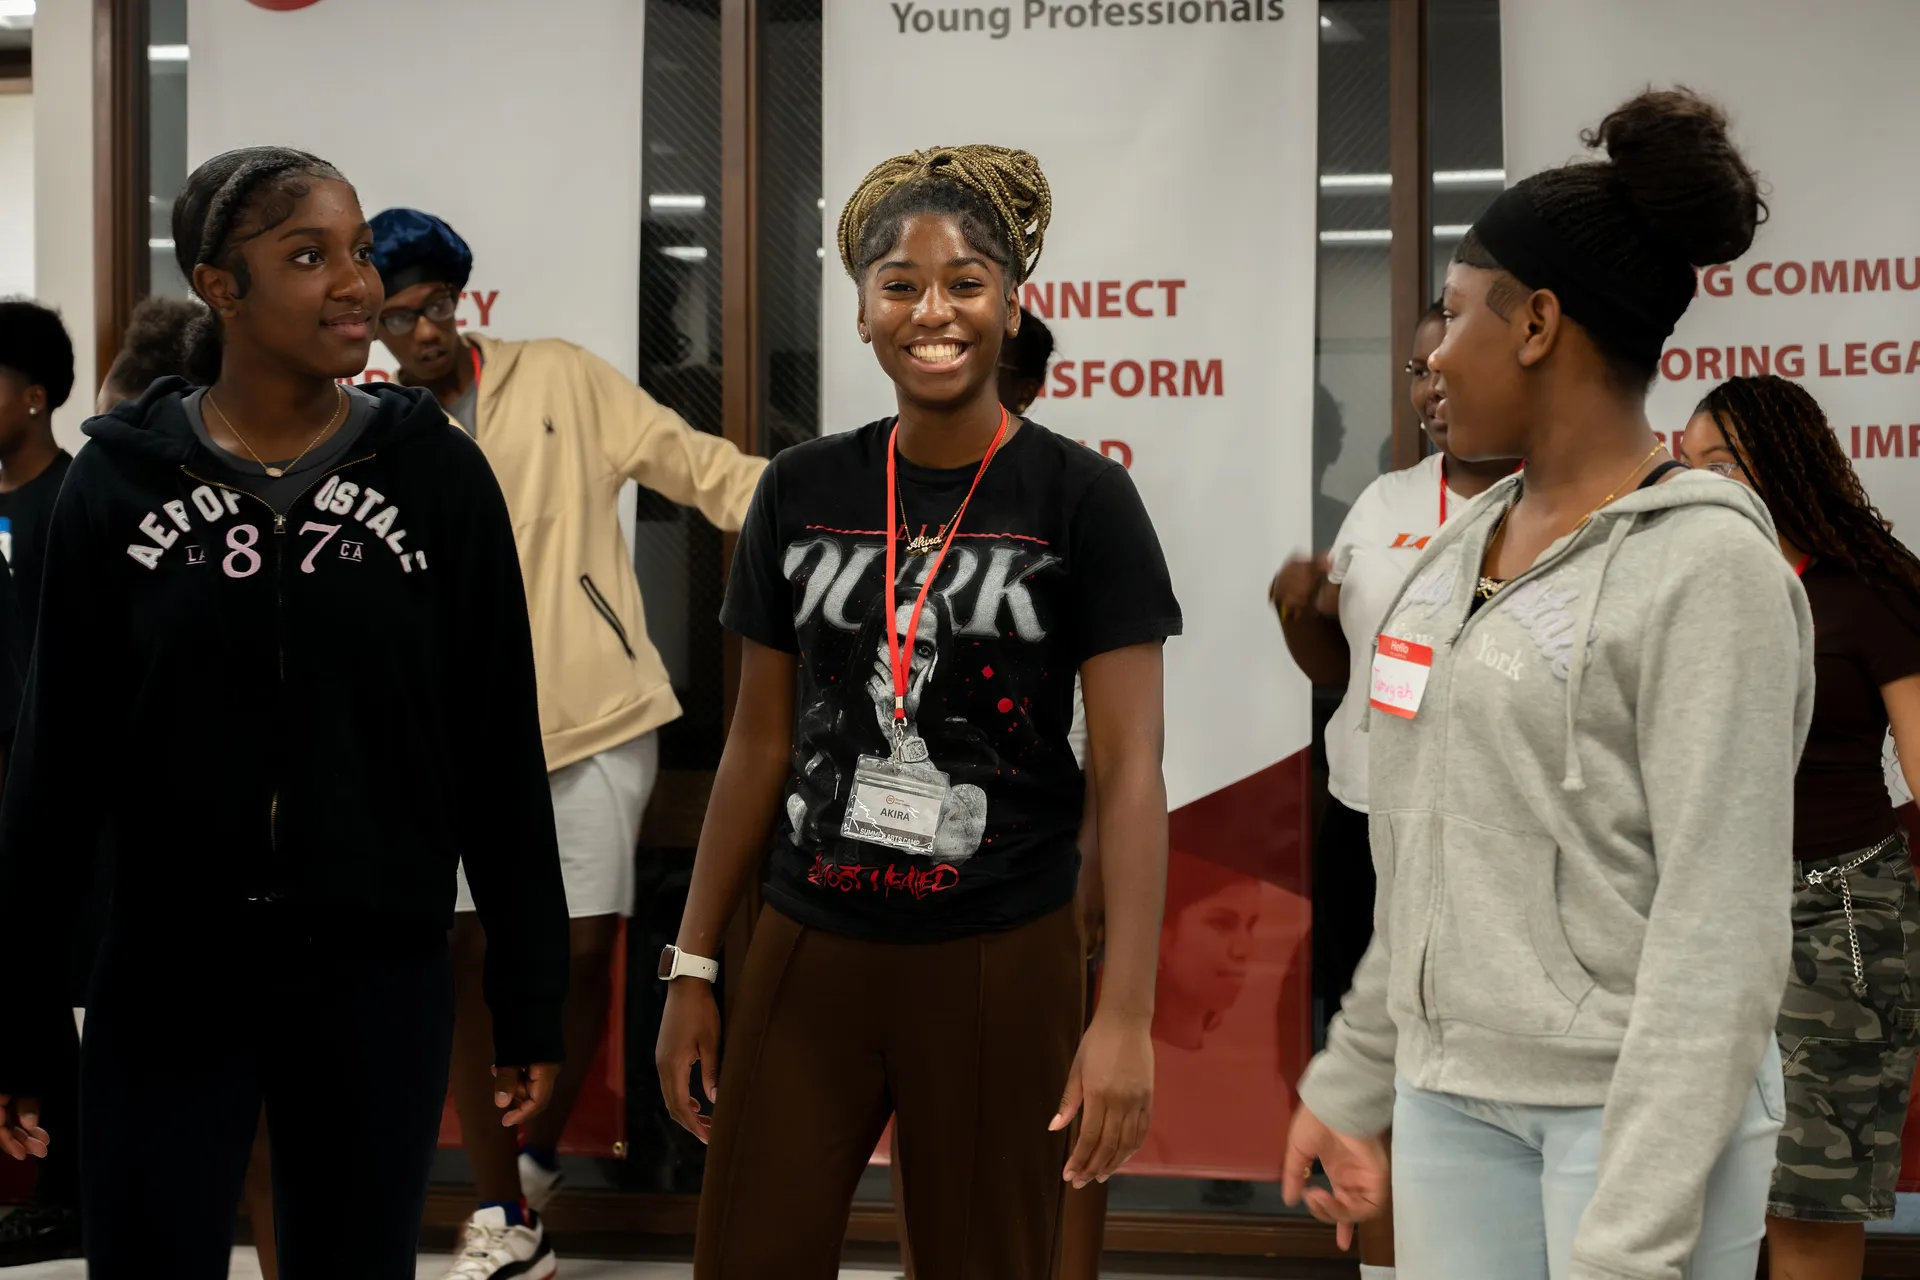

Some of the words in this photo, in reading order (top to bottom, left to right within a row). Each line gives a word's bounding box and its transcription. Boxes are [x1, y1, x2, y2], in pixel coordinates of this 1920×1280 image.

[890, 2, 1011, 39] Young
[1023, 0, 1284, 29] Professionals
[1746, 256, 1920, 296] COMMU
[1036, 359, 1223, 399] SFORM
[222, 524, 262, 578] 8
[298, 521, 342, 573] 7
[339, 543, 362, 559] CA
[1390, 639, 1409, 654] Hello
[1475, 633, 1526, 681] York
[880, 807, 910, 821] AKIRA
